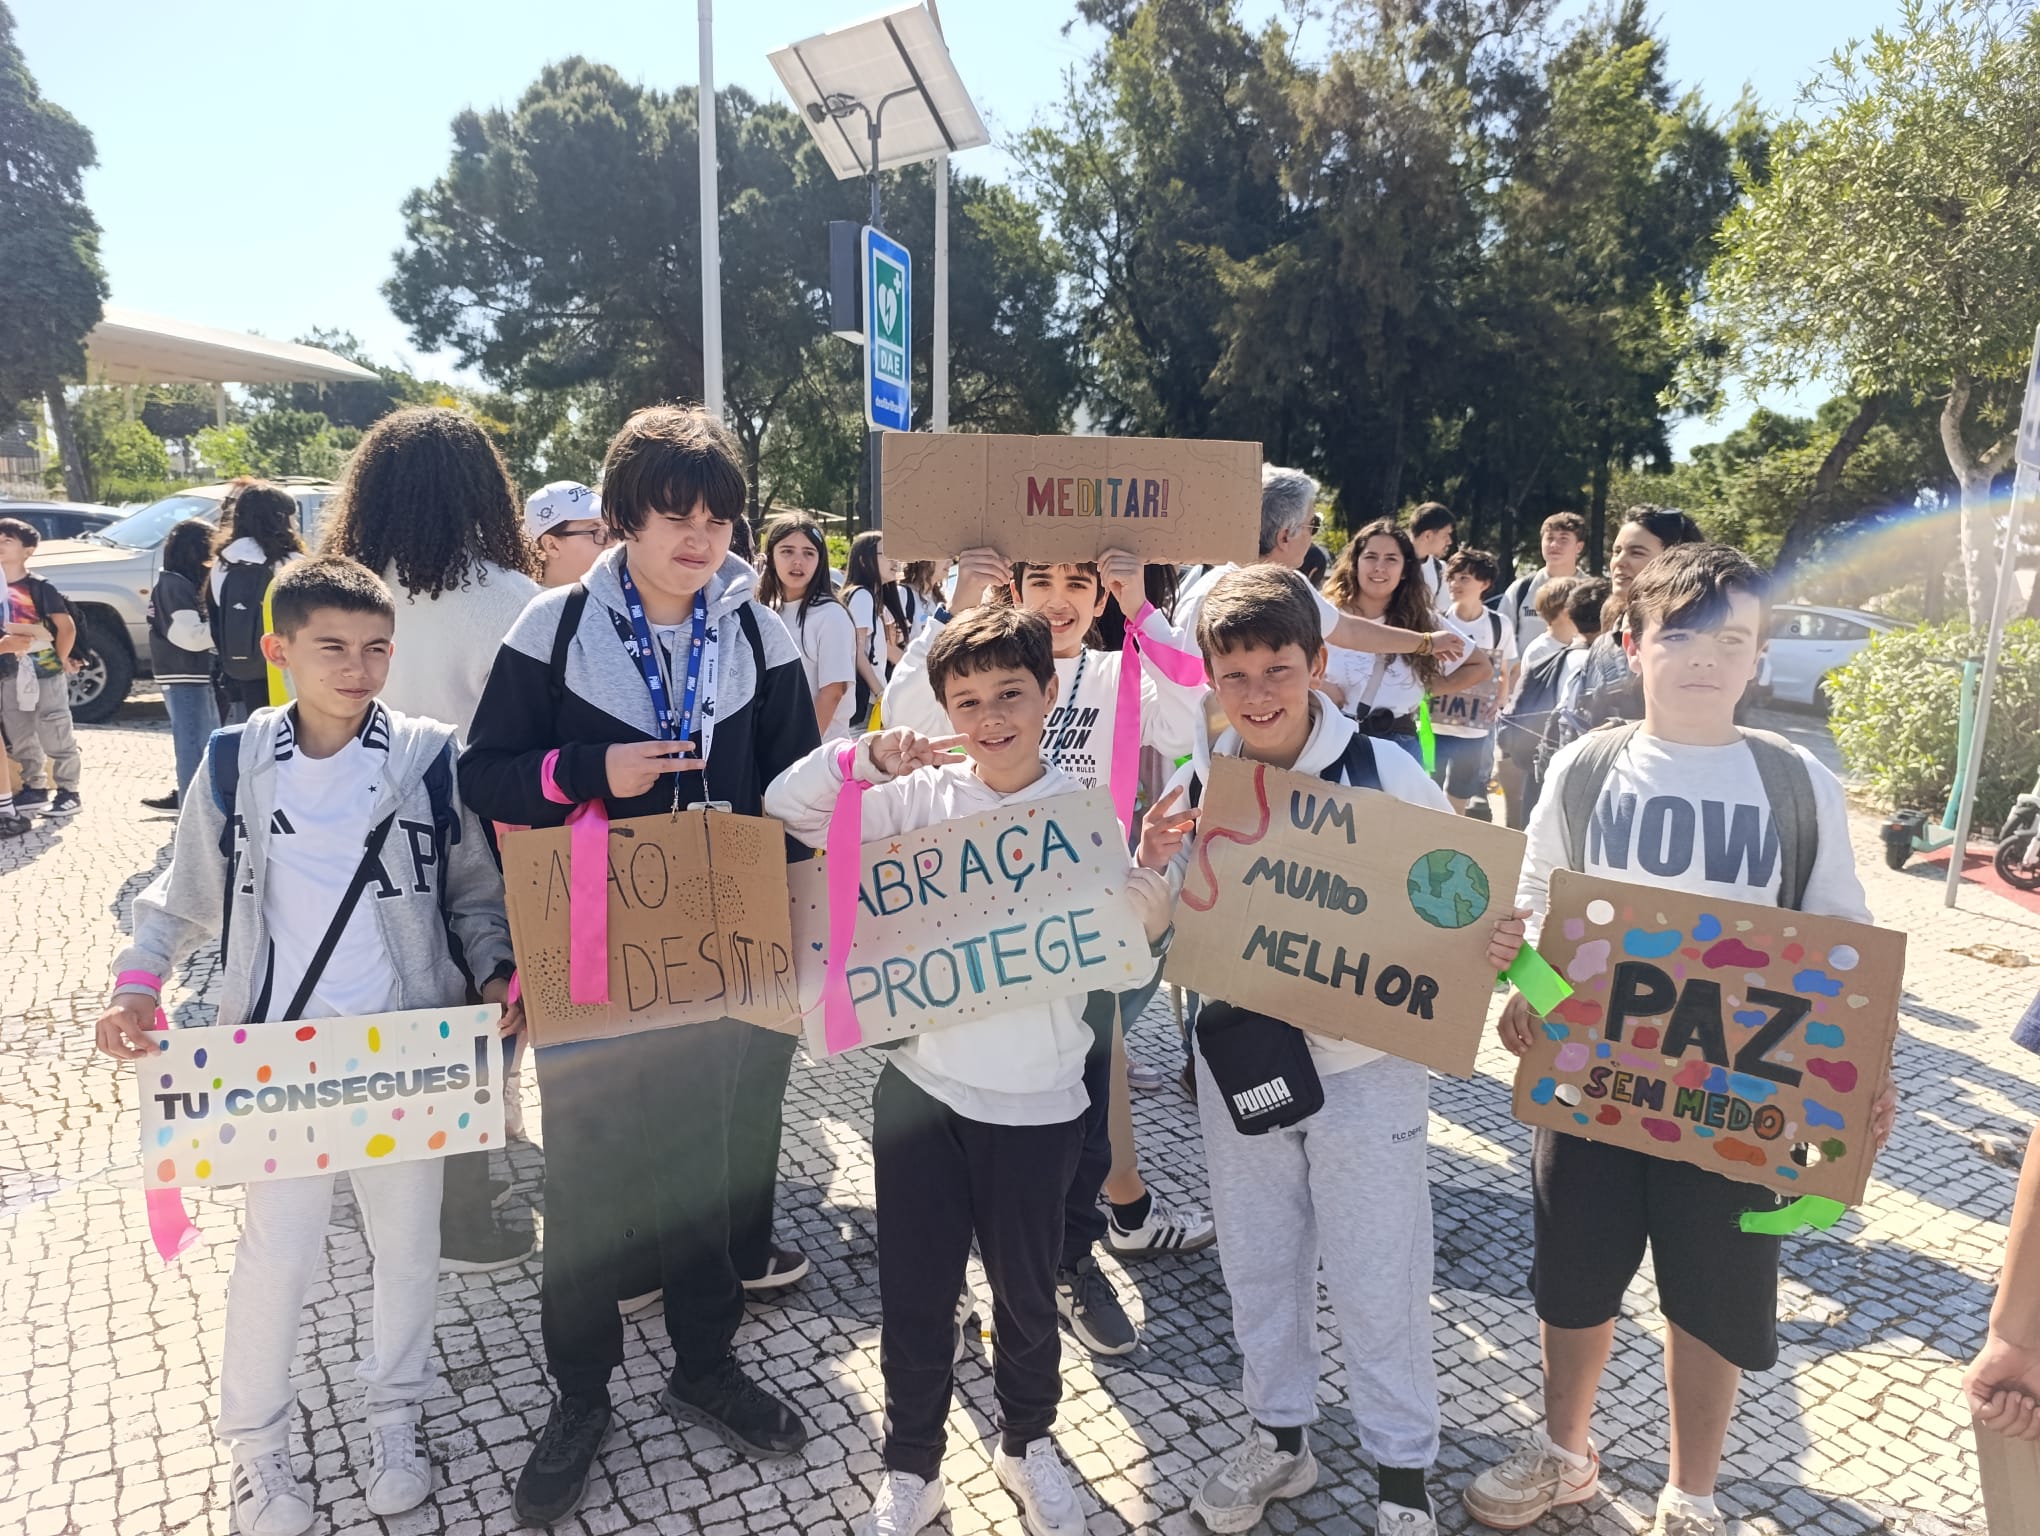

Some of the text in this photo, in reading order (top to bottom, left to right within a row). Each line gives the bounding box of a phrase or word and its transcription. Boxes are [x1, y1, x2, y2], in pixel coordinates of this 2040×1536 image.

[880, 350, 900, 376] DAE
[1027, 476, 1169, 518] MEDITAR!
[1290, 789, 1357, 845] UM
[1590, 790, 1779, 888] NOW
[1241, 856, 1368, 915] MUNDO
[623, 930, 796, 1013] DESISTIR
[846, 907, 1107, 1018] PROTEGE
[1241, 925, 1439, 1020] MELHOR
[1603, 960, 1812, 1088] PAZ
[154, 1092, 210, 1120] TU
[1232, 1076, 1291, 1115] PUMA
[1672, 1086, 1785, 1141] MEDO
